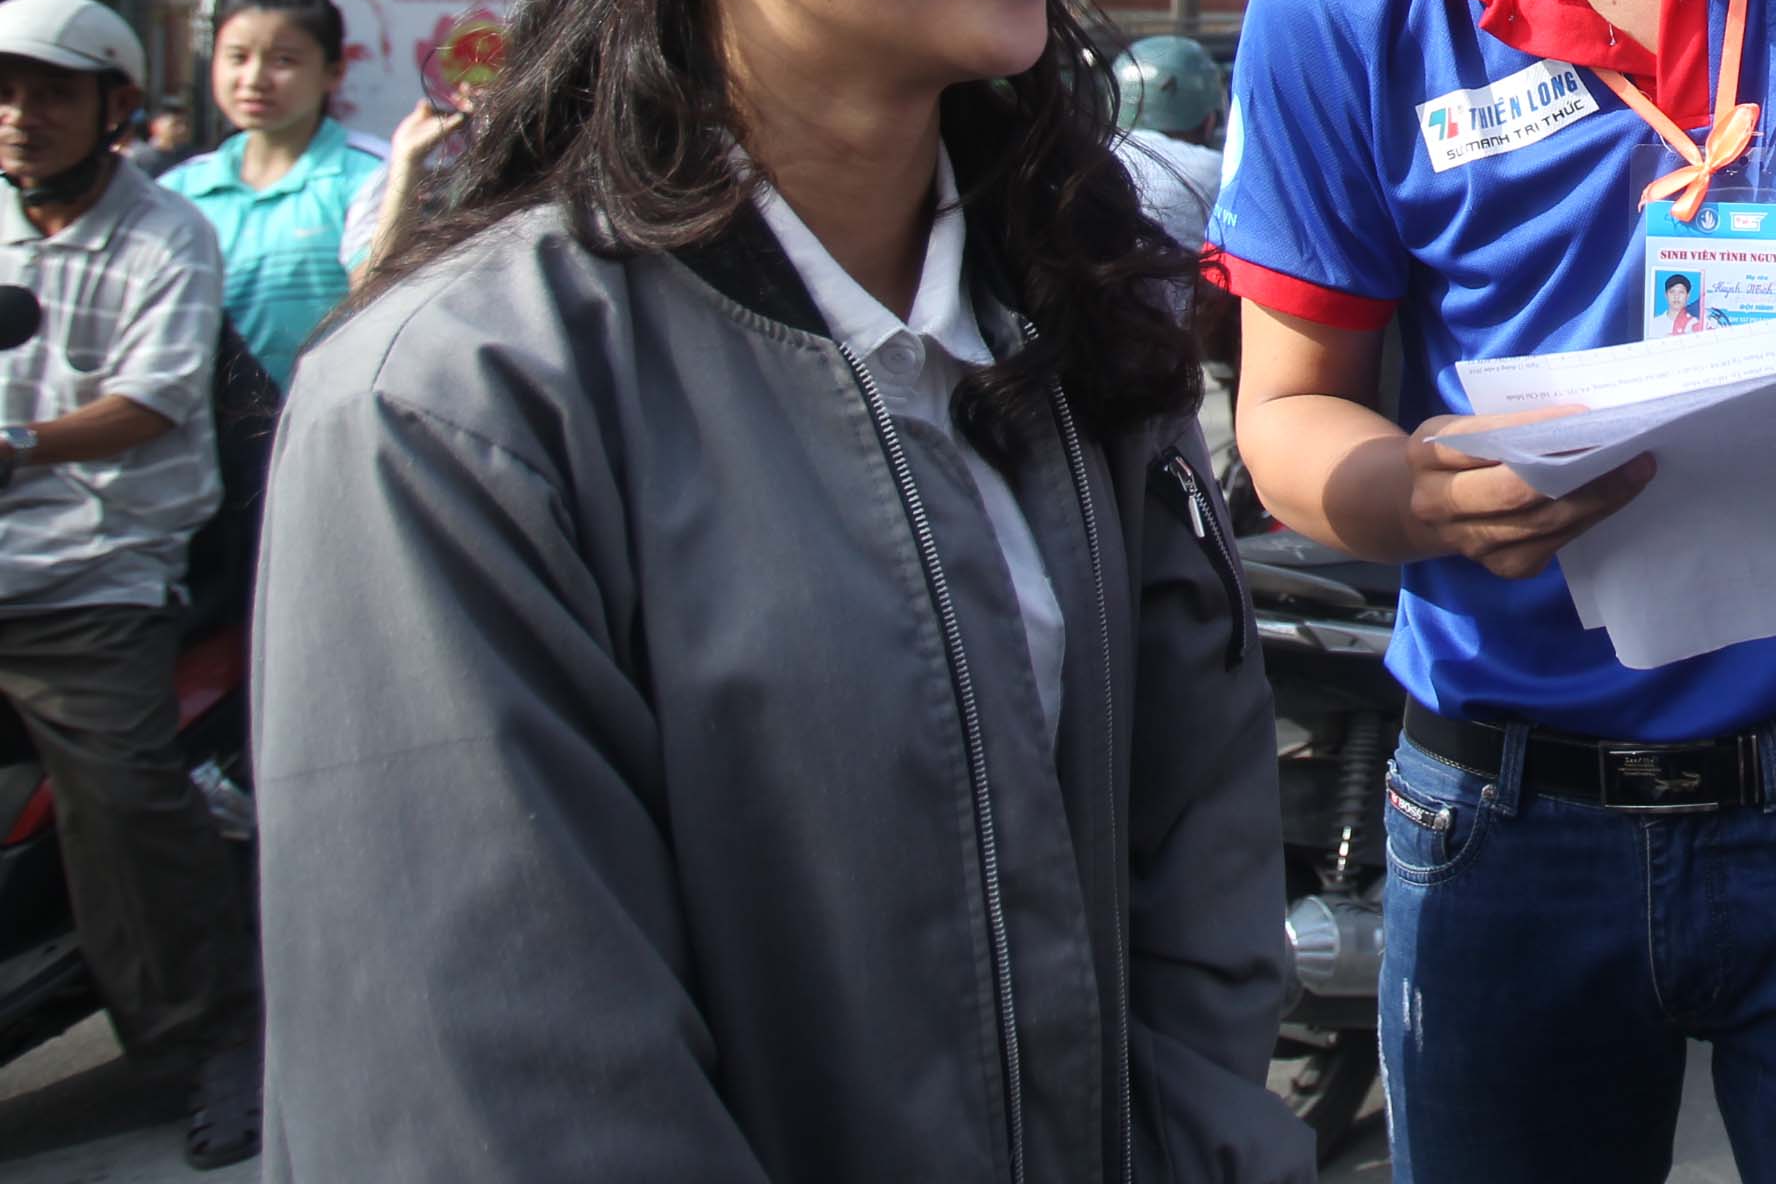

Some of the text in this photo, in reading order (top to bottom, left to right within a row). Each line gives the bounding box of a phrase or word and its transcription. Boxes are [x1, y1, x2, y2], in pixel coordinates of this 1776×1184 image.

[1469, 72, 1578, 131] THIÊN LONG
[1513, 122, 1540, 139] TRI
[1660, 250, 1687, 261] SINH
[1690, 249, 1717, 261] VIÊN
[1719, 250, 1747, 262] TÌNH
